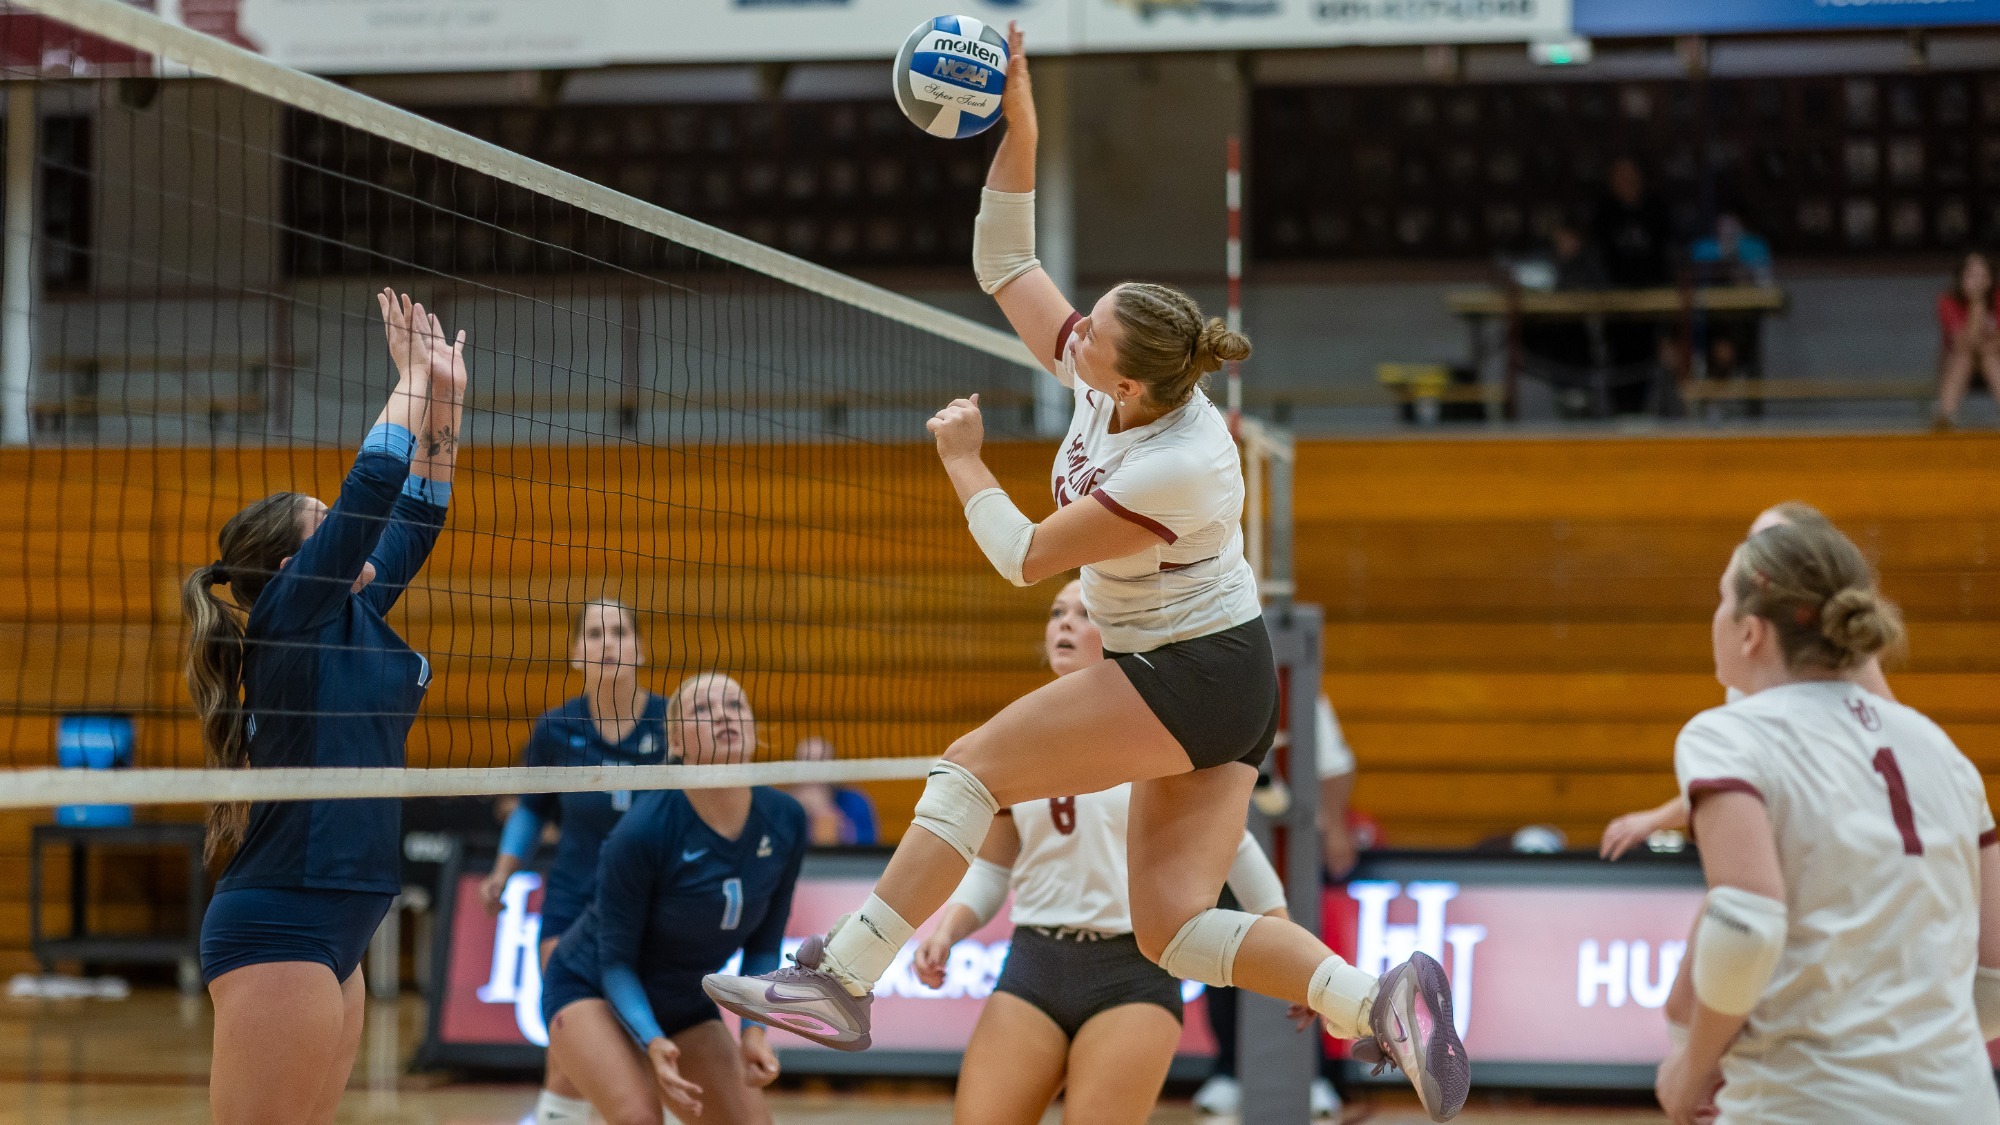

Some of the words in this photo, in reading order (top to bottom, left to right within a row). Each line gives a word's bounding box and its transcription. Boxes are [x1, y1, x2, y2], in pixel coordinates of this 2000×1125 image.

[932, 56, 989, 86] NCAA
[933, 38, 999, 67] molten
[924, 83, 954, 100] Super
[956, 94, 988, 108] Touch
[1050, 796, 1076, 835] 8
[1872, 747, 1925, 856] 1
[720, 878, 744, 930] 1
[1576, 937, 1688, 1009] HU
